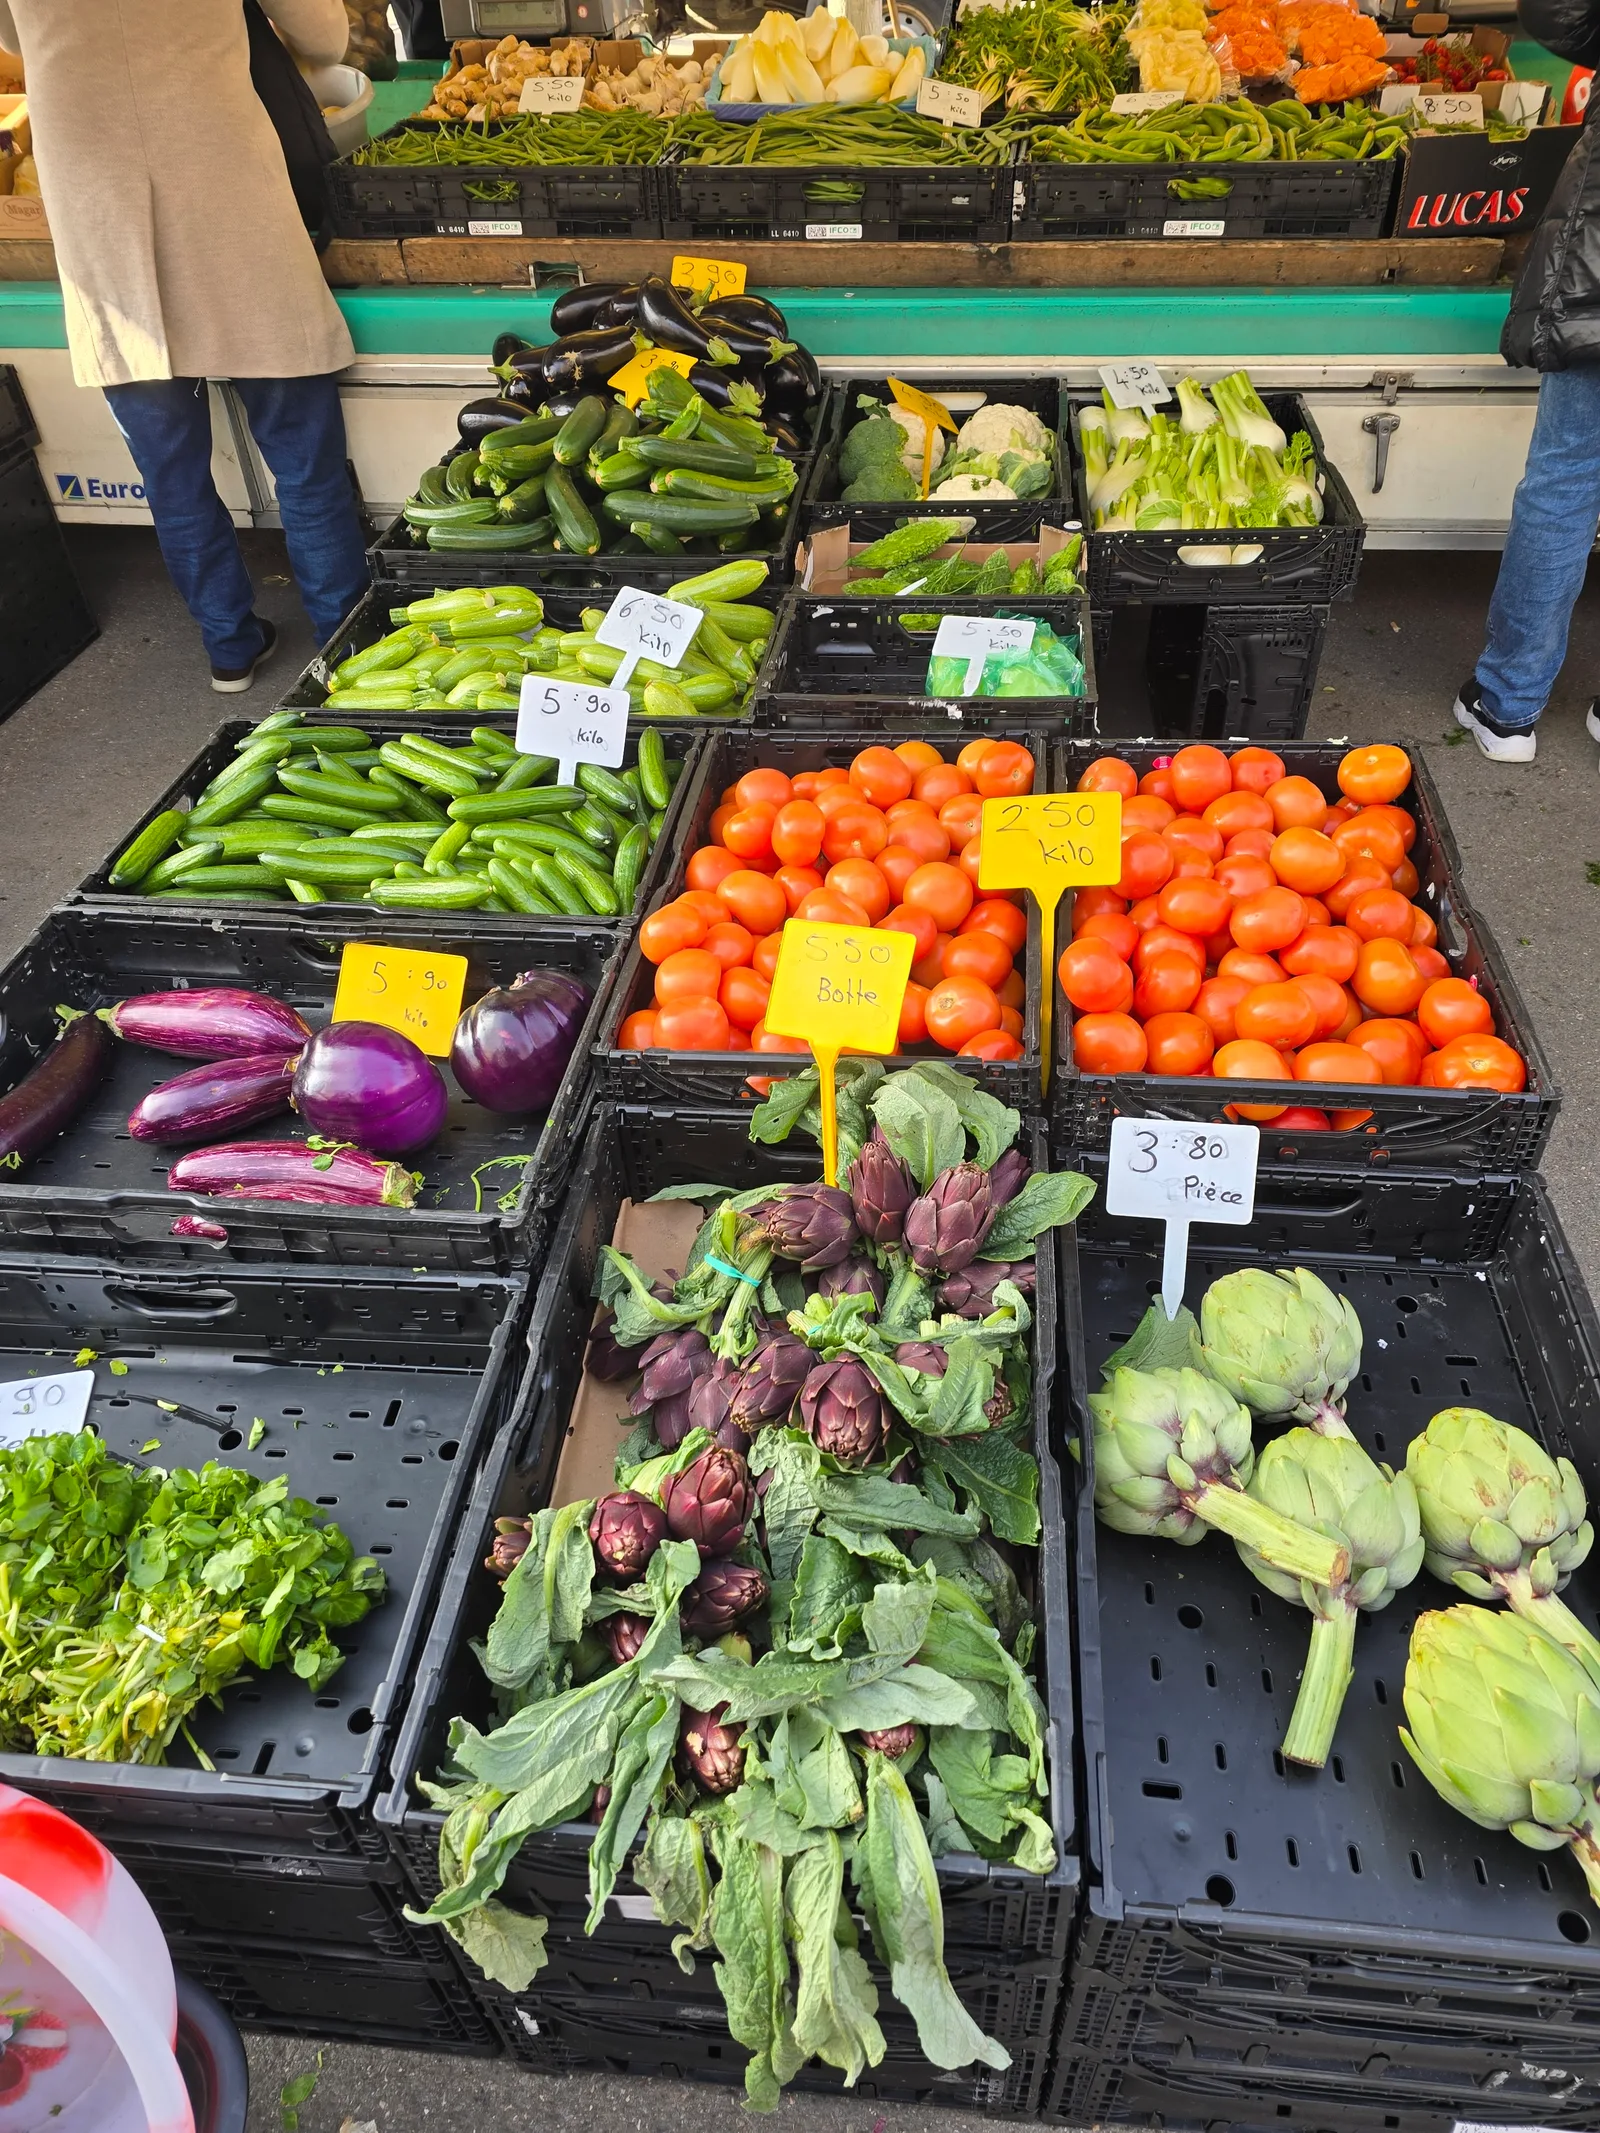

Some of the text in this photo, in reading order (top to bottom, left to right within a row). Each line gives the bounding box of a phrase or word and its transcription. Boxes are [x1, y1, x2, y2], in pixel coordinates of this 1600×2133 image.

[1407, 187, 1530, 229] LUCAS
[491, 223, 510, 231] IFCO
[1190, 222, 1211, 230] IFCO
[87, 478, 146, 500] Euro
[816, 976, 882, 1008] Botte
[1184, 1175, 1246, 1205] Pièce
